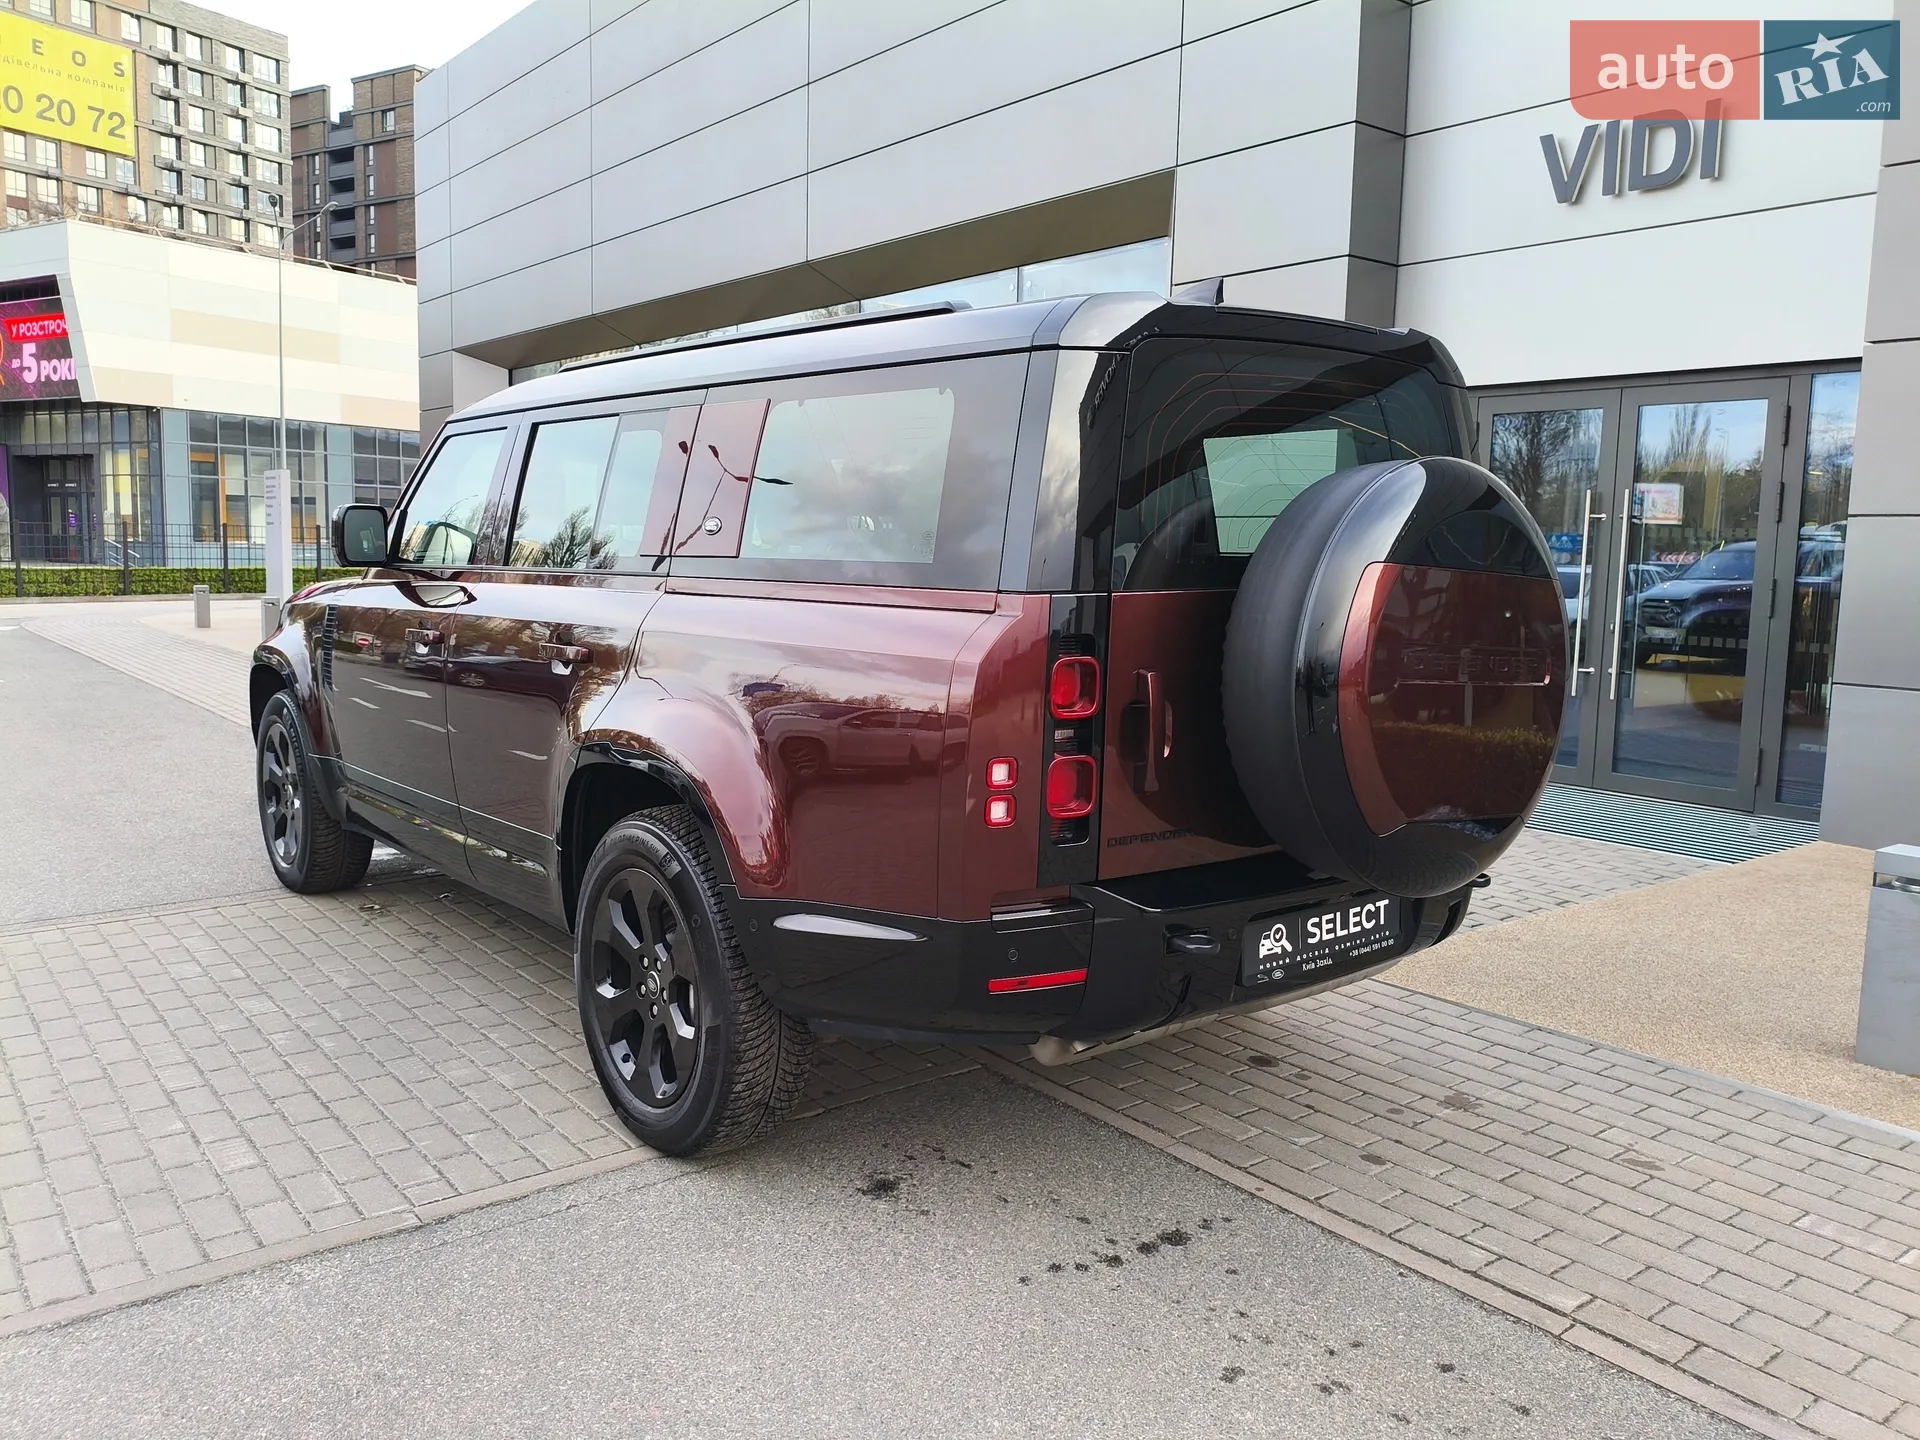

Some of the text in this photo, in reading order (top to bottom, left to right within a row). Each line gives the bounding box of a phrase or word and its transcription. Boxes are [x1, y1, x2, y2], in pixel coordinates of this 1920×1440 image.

[0, 37, 125, 79] EOS
[0, 54, 125, 93] дівельна компанія
[0, 85, 126, 140] 0 20 72
[1539, 98, 1727, 204] VIDI
[22, 342, 38, 384] 5
[40, 358, 78, 382] РОКІ
[1306, 899, 1389, 944] SELECT
[1260, 956, 1290, 970] НОВИЙ
[1297, 947, 1329, 962] ДОСВІД
